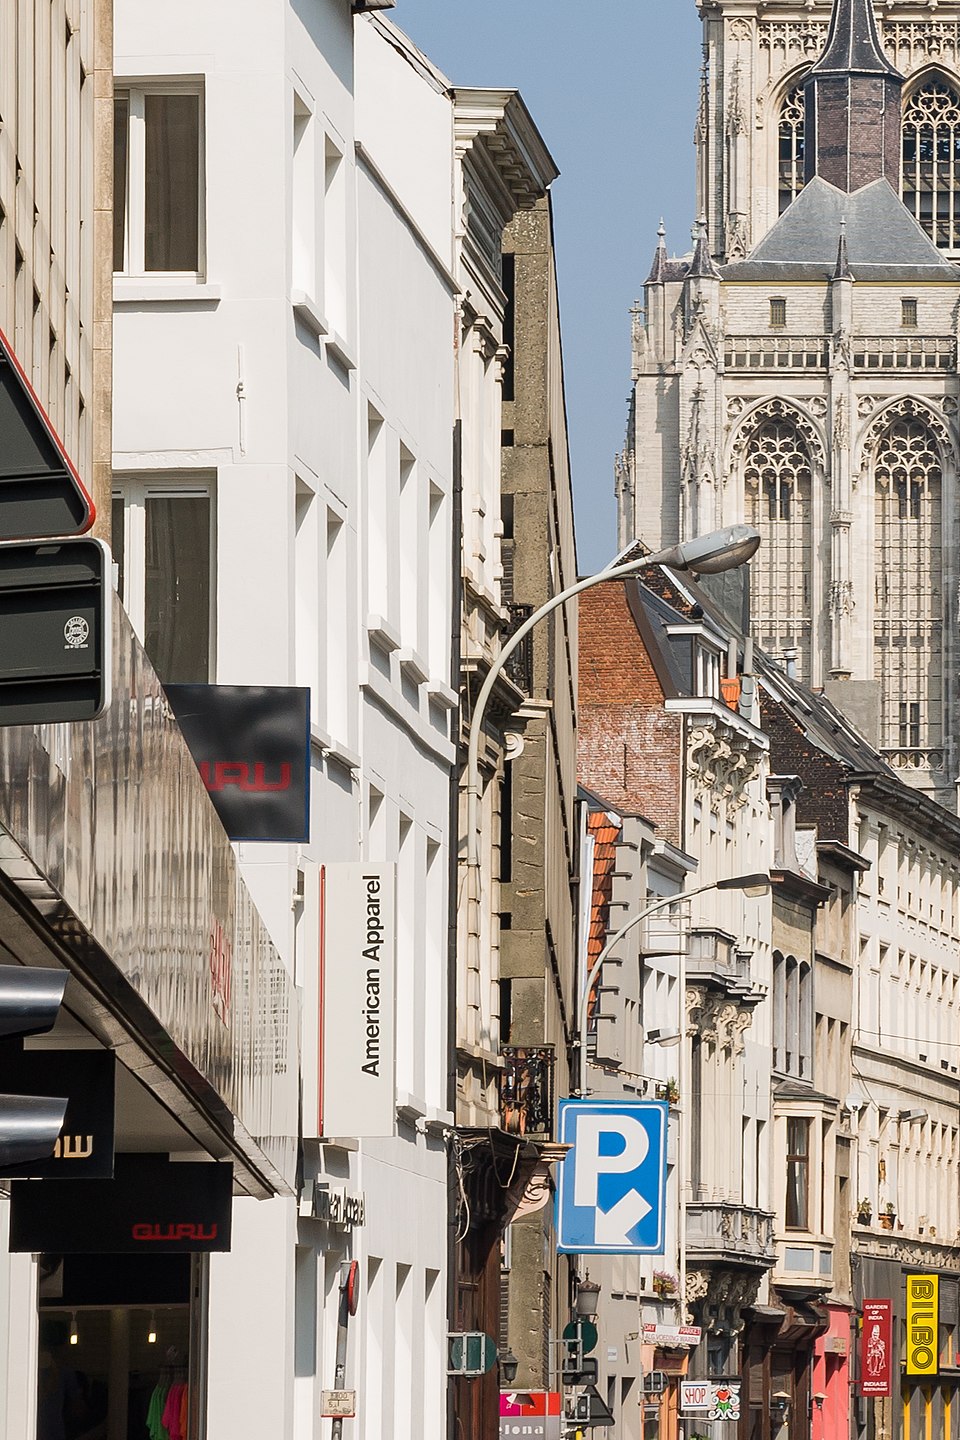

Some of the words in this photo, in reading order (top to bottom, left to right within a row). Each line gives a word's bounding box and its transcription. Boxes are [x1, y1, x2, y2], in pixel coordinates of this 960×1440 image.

[361, 875, 385, 962] Apparel
[361, 968, 380, 1078] American
[574, 1114, 650, 1207] P
[131, 1223, 218, 1241] GURU
[911, 1279, 935, 1370] BILBO
[684, 1388, 706, 1404] SHOP
